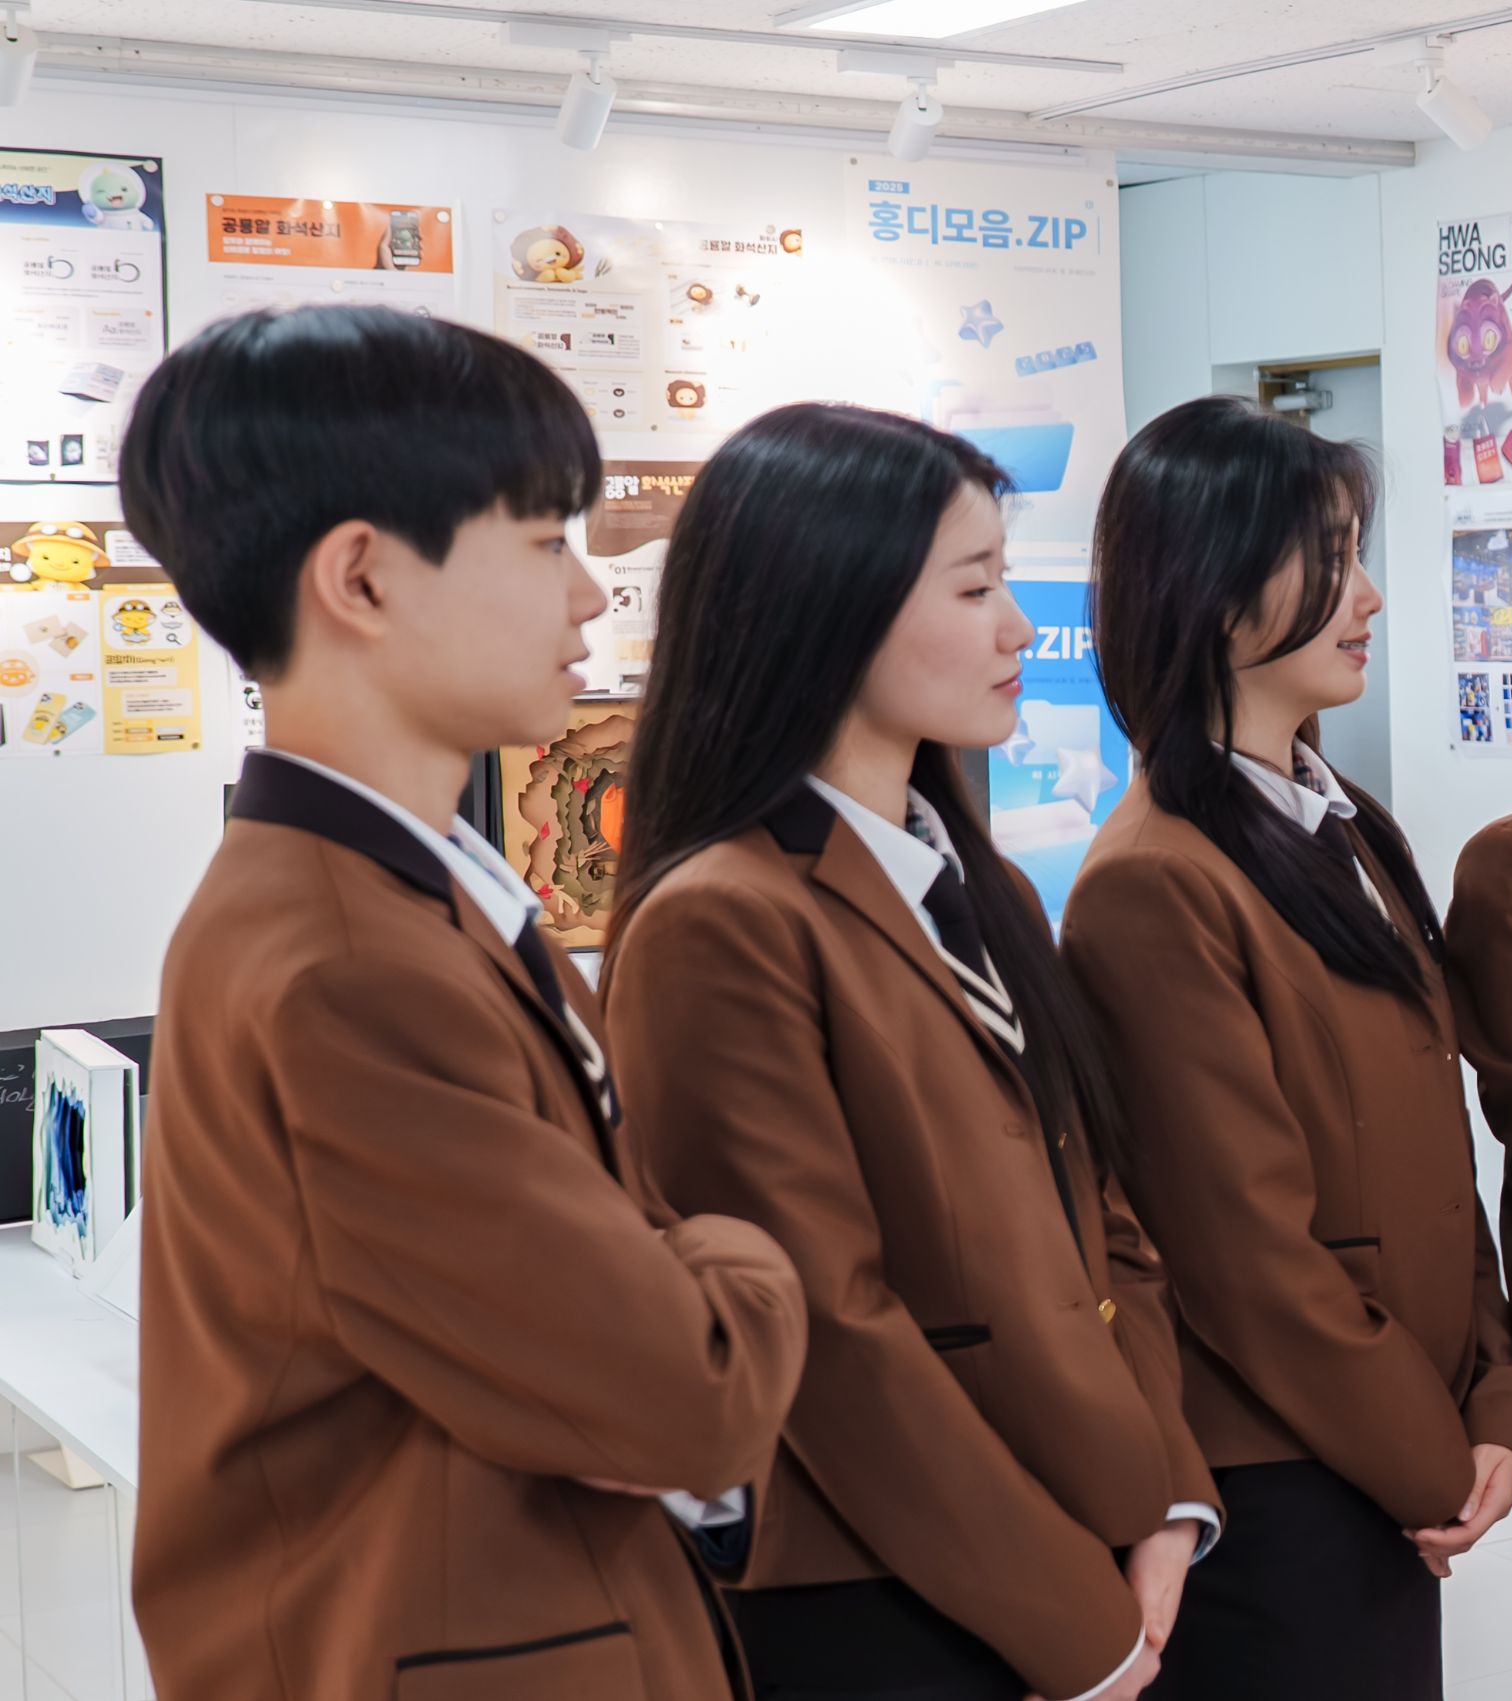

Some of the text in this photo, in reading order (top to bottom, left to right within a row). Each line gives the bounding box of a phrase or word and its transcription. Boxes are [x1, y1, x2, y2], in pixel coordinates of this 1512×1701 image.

[222, 217, 341, 238] 공룡알 화석산지
[868, 200, 1087, 249] 홍디모음.ZIP
[1439, 222, 1482, 251] HWA
[734, 240, 778, 255] 화석산지
[1439, 243, 1506, 275] SEONG
[1024, 626, 1095, 660] .ZIP
